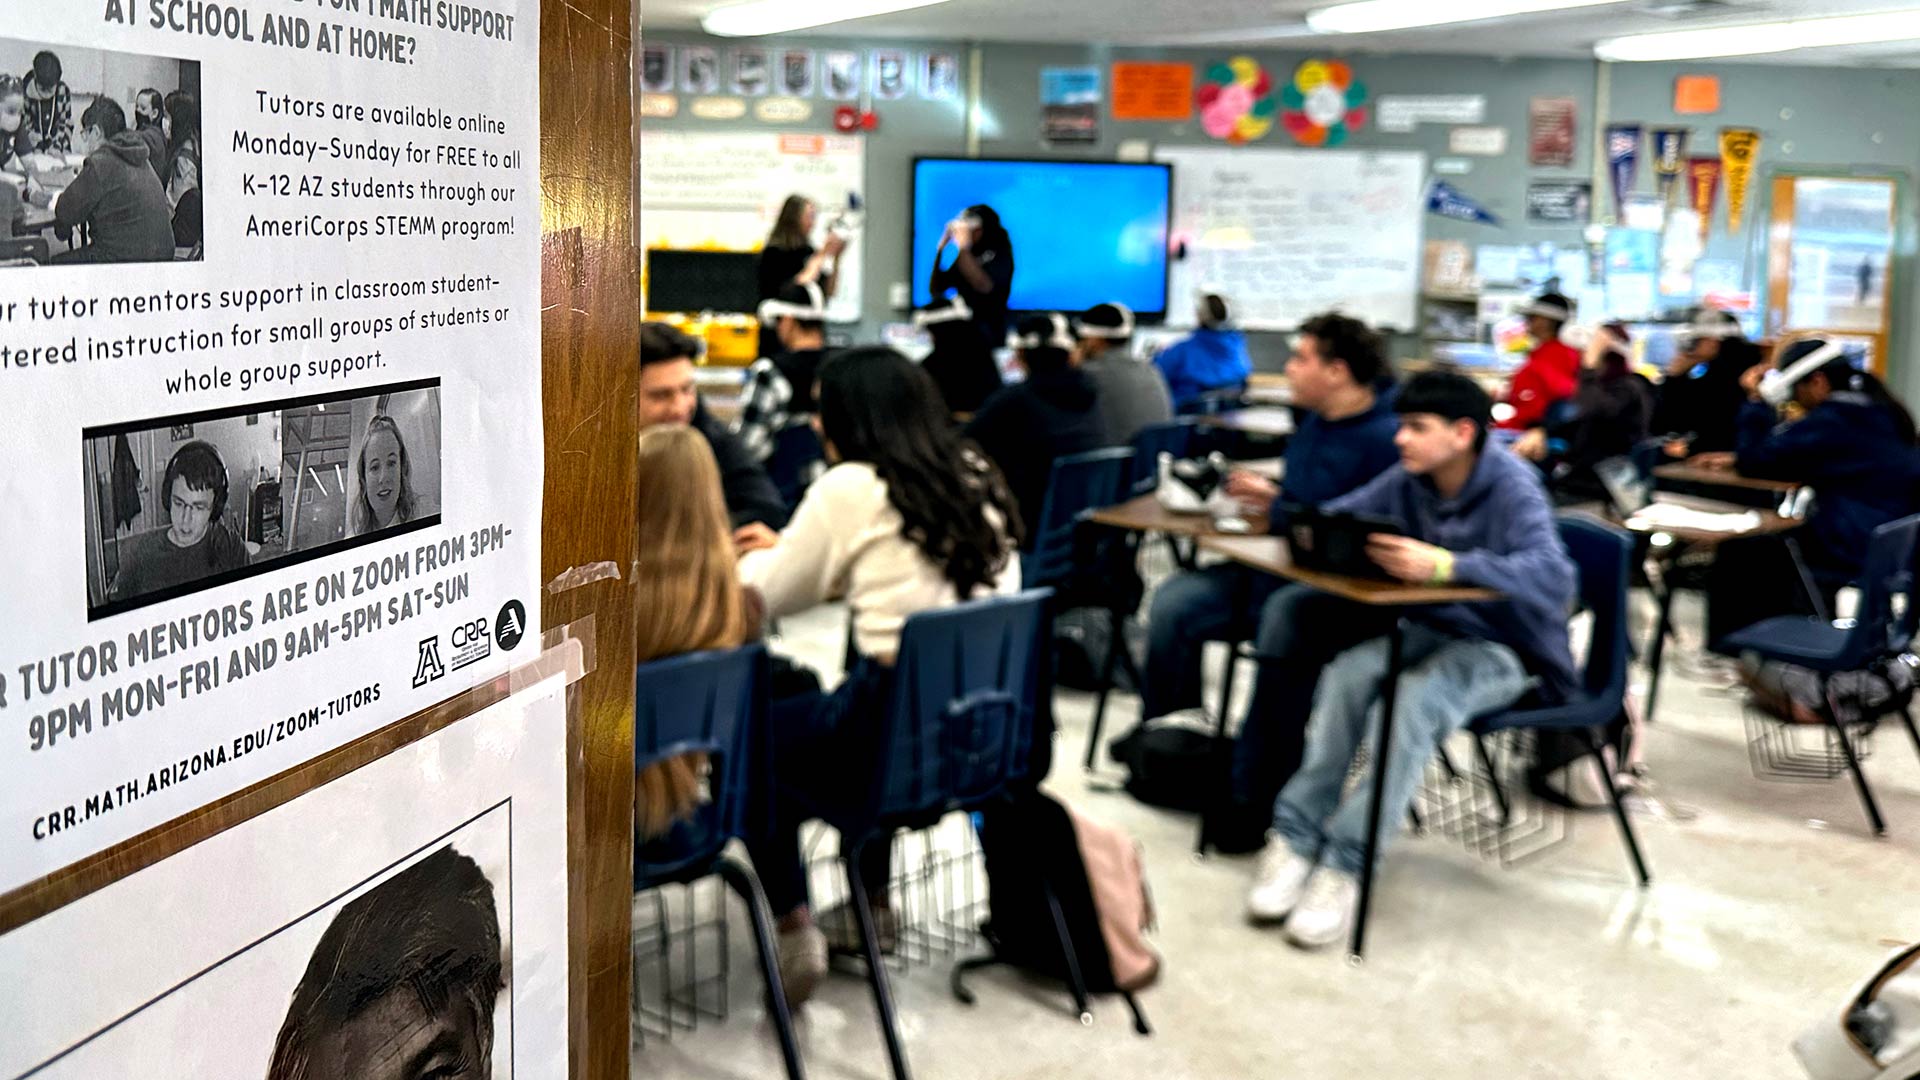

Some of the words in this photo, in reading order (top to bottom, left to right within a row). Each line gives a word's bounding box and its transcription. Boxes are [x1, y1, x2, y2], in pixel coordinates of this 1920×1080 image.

[108, 0, 136, 25] AT
[150, 0, 255, 43] SCHOOL
[261, 13, 311, 49] AND
[317, 22, 343, 54] AT
[350, 27, 416, 65] HOME?
[380, 0, 431, 27] MATH
[437, 1, 514, 41] SUPPORT
[256, 90, 325, 119] Tutors
[333, 103, 364, 122] are
[371, 105, 452, 130] available
[458, 113, 506, 135] online
[233, 130, 400, 168] Monday-Sunday
[406, 141, 431, 164] for
[437, 145, 477, 168] FREE
[482, 149, 498, 168] to
[503, 149, 521, 170] all
[243, 173, 291, 197] K-12
[299, 175, 323, 198] AZ
[331, 178, 414, 201] students
[420, 178, 485, 206] through
[491, 187, 515, 202] our
[246, 214, 368, 243] AmeriCorps
[376, 215, 436, 236] STEMM
[442, 219, 515, 241] program!
[29, 294, 98, 320] tutor
[110, 289, 212, 316] mentors
[220, 282, 304, 311] support
[310, 282, 328, 302] in
[335, 279, 425, 301] classroom
[432, 273, 499, 295] student-
[0, 336, 77, 369] tered
[88, 326, 223, 361] instruction
[231, 323, 262, 347] for
[270, 316, 323, 344] small
[330, 318, 392, 345] groups
[399, 310, 415, 331] of
[421, 309, 489, 329] students
[495, 308, 510, 322] or
[166, 363, 232, 395] whole
[240, 359, 301, 391] group
[308, 349, 387, 379] support.
[18, 639, 118, 701] TUTOR
[128, 605, 254, 667] MENTORS
[262, 582, 308, 640] ARE
[315, 566, 345, 609] ON
[352, 551, 409, 597] ZOOM
[416, 535, 465, 576] FROM
[470, 528, 512, 558] 3PM-
[29, 697, 92, 751] 9PM
[102, 655, 220, 728] MON-FRI
[227, 636, 277, 684] AND
[284, 605, 381, 663] 9AM-5PM
[388, 571, 469, 626] SAT-SUN
[32, 683, 382, 841] CRR.MATH.ARIZONA.EDU/ZOOM-TUTORS
